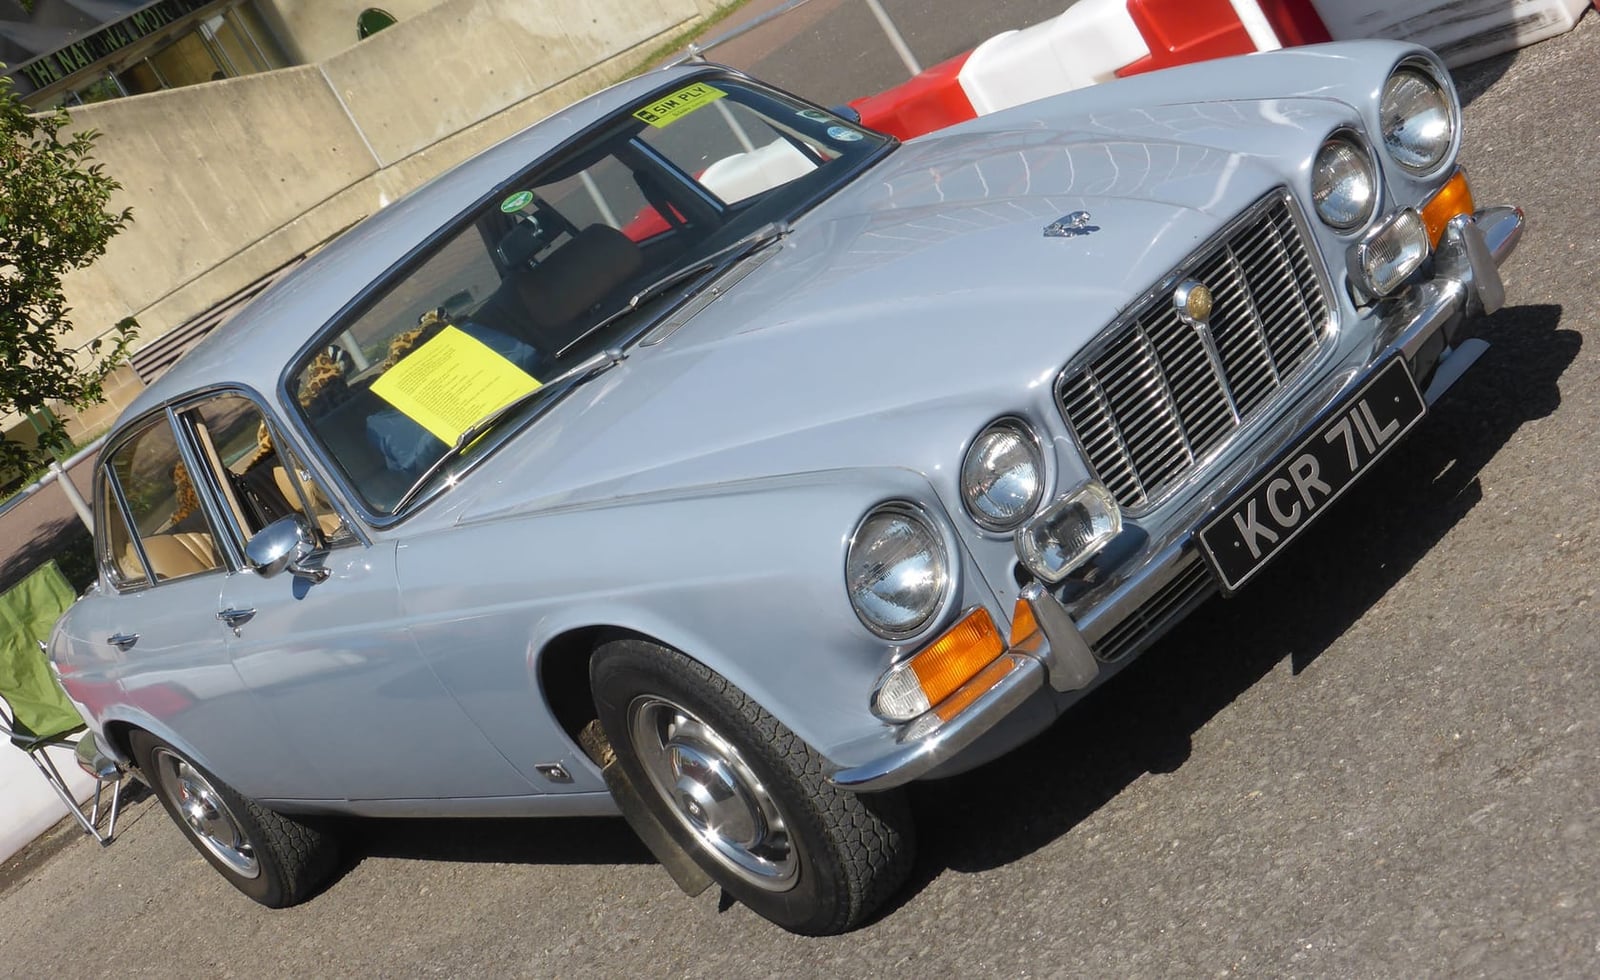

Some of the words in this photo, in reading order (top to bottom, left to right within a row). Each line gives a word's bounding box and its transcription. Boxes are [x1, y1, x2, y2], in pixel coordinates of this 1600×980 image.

[21, 56, 63, 89] THE
[55, 19, 139, 74] NATNAL
[679, 87, 706, 101] PLY
[1233, 453, 1332, 560] KCR
[1324, 398, 1400, 472] 71L
